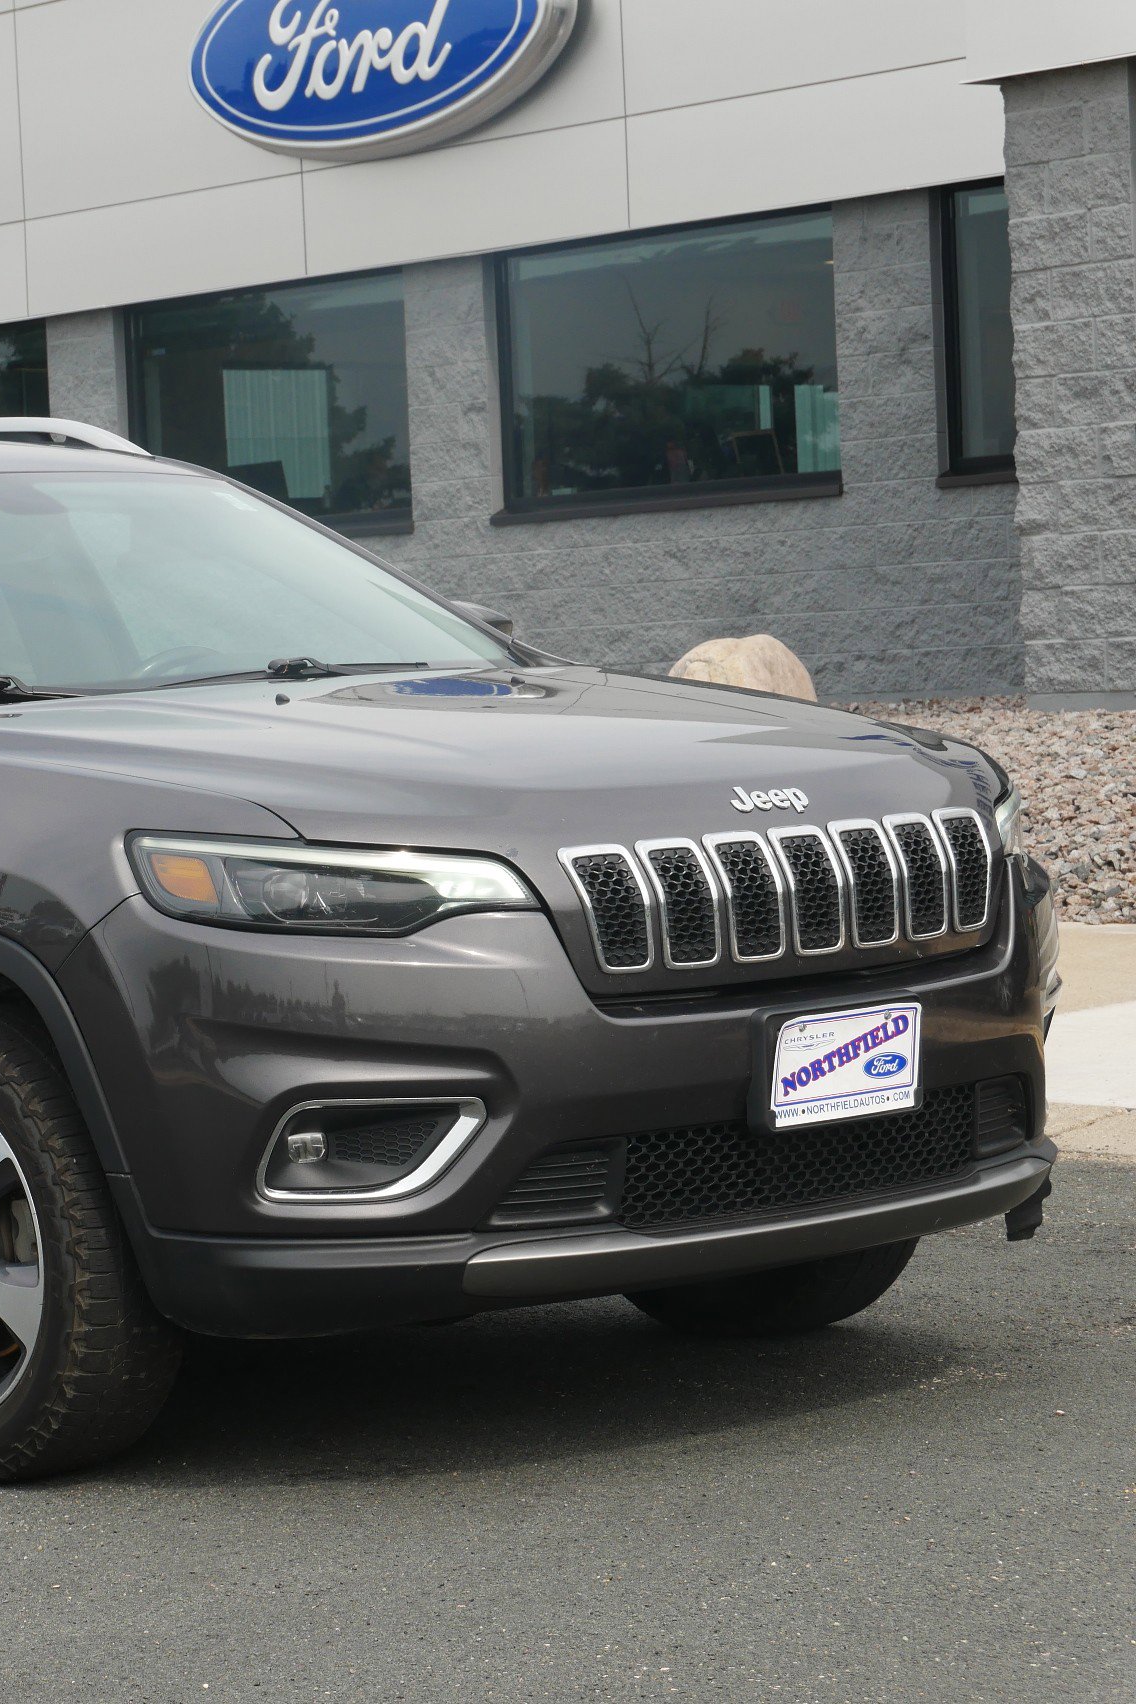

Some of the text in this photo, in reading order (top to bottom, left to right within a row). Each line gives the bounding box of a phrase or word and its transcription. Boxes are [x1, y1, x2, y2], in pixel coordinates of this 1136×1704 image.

[253, 0, 452, 112] Ford
[730, 786, 809, 813] Jeep
[784, 1031, 835, 1045] CHRYSLER
[780, 1014, 910, 1098] NORTHFIELD
[871, 1056, 899, 1075] Ford
